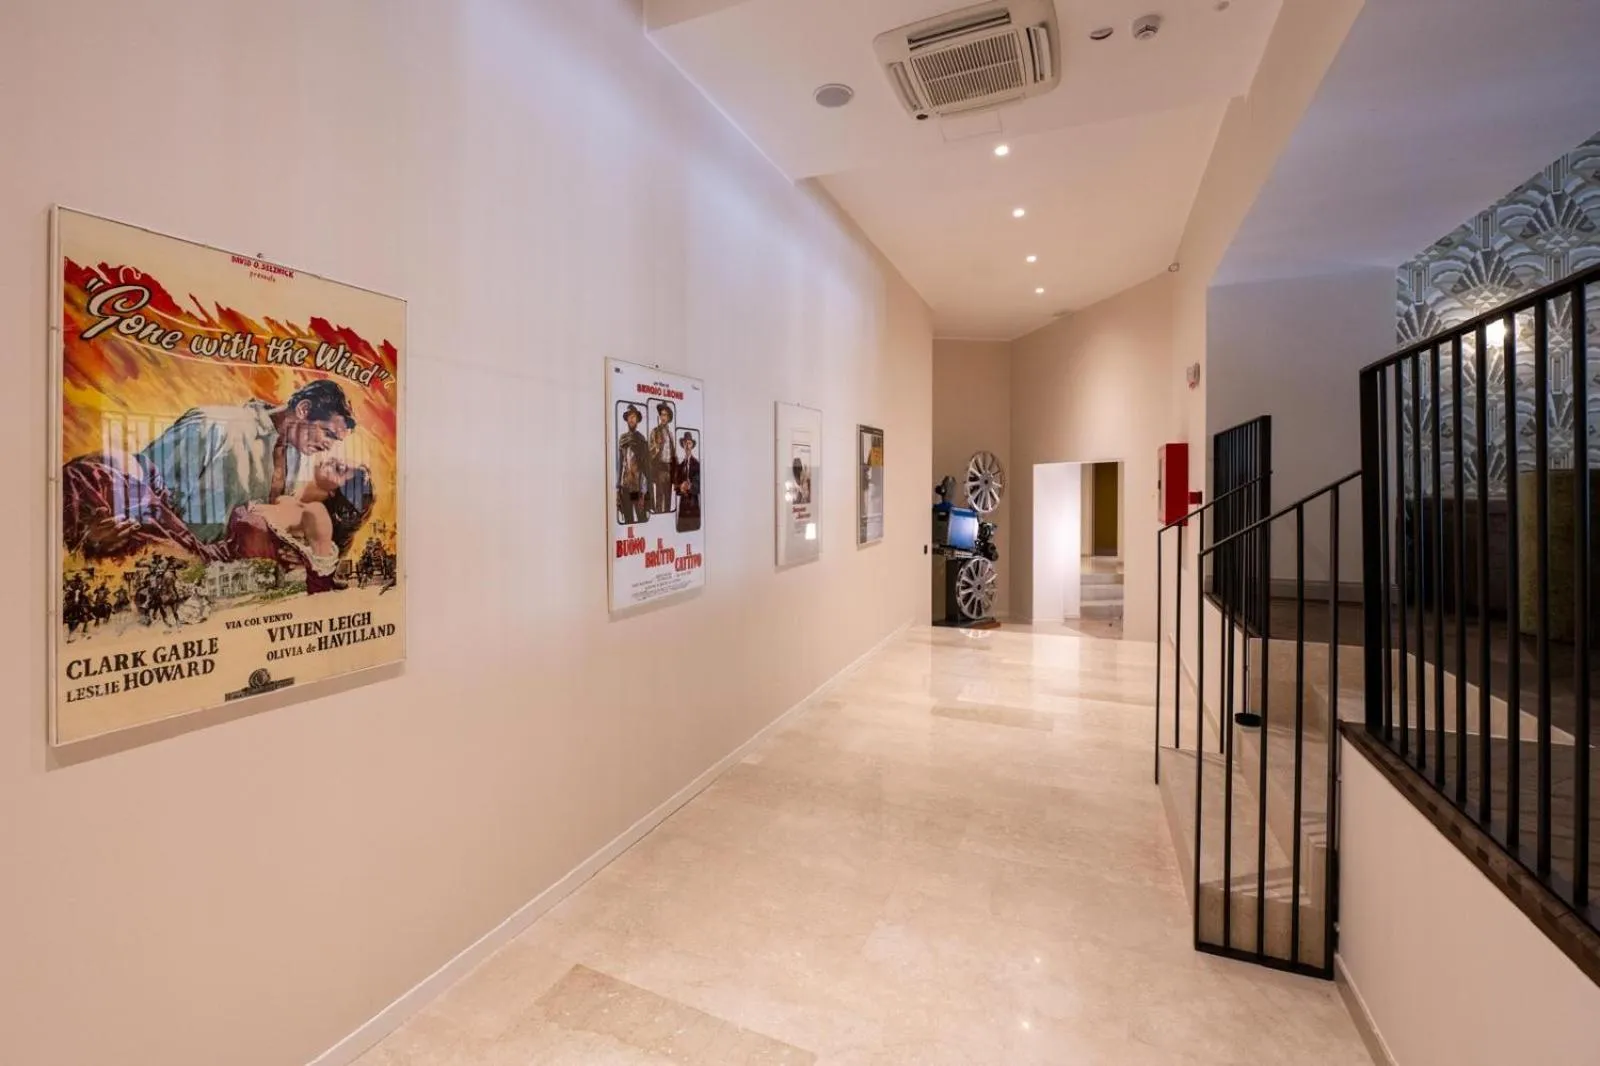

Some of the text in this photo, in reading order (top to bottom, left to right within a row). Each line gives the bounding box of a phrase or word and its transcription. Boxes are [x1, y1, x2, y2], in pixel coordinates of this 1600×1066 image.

[190, 330, 258, 363] with
[266, 336, 309, 365] the
[637, 383, 662, 396] SERGIO
[663, 389, 684, 400] LEONE
[616, 537, 645, 558] BUONO
[225, 612, 293, 630] VIA COL VENTO
[267, 611, 371, 643] VIVIEN LEIGH
[266, 623, 396, 661] OLIVIA de HAVILLAND
[66, 637, 219, 681] CLARK GABLE
[66, 680, 120, 703] LESLIE
[123, 658, 216, 692] HOWARD
